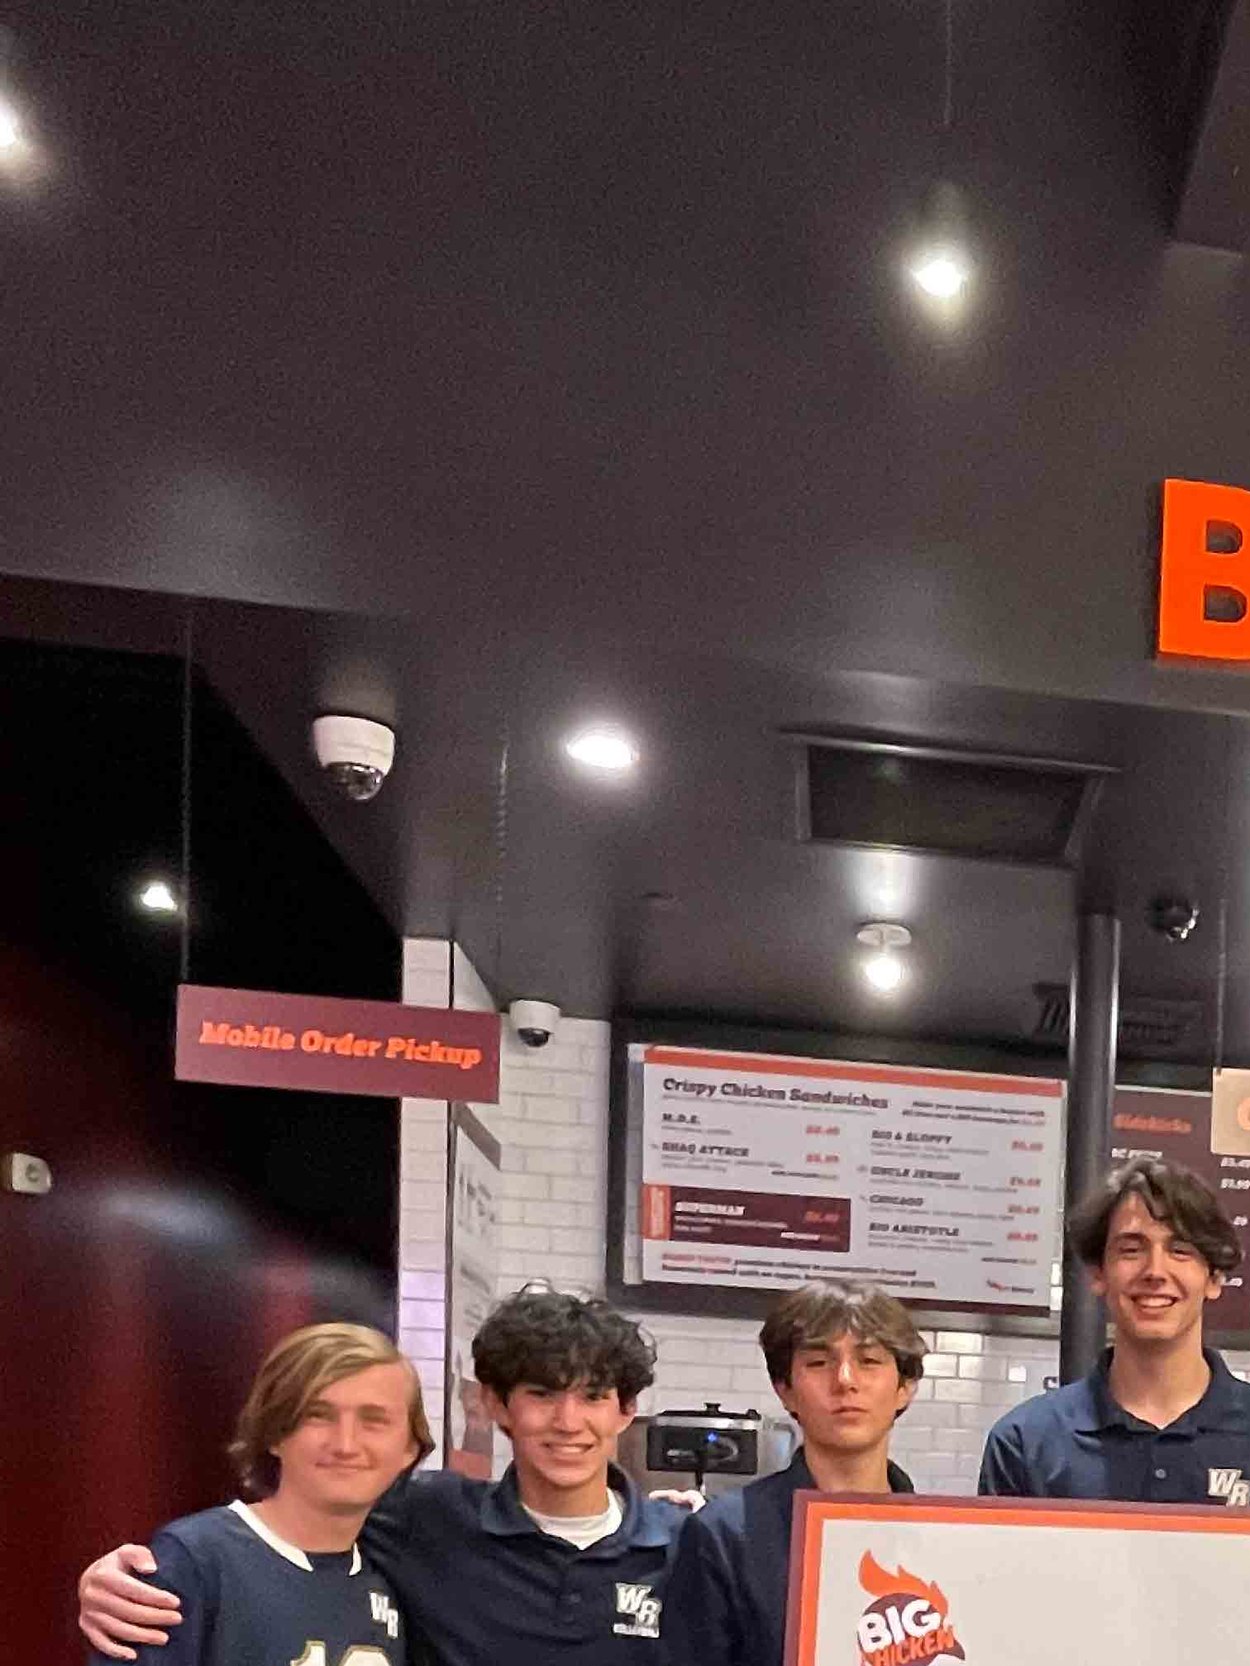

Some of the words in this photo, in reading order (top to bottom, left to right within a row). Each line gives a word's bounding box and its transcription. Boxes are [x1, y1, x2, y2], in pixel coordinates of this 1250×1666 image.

[199, 1021, 296, 1050] Mobile
[301, 1030, 383, 1057] Order
[385, 1037, 482, 1069] Pickup
[663, 1078, 717, 1097] Crispy
[721, 1083, 786, 1100] Chicken
[790, 1088, 888, 1109] Sandwiches
[369, 1589, 398, 1638] WR
[615, 1582, 663, 1627] WR
[857, 1599, 940, 1652] BIG
